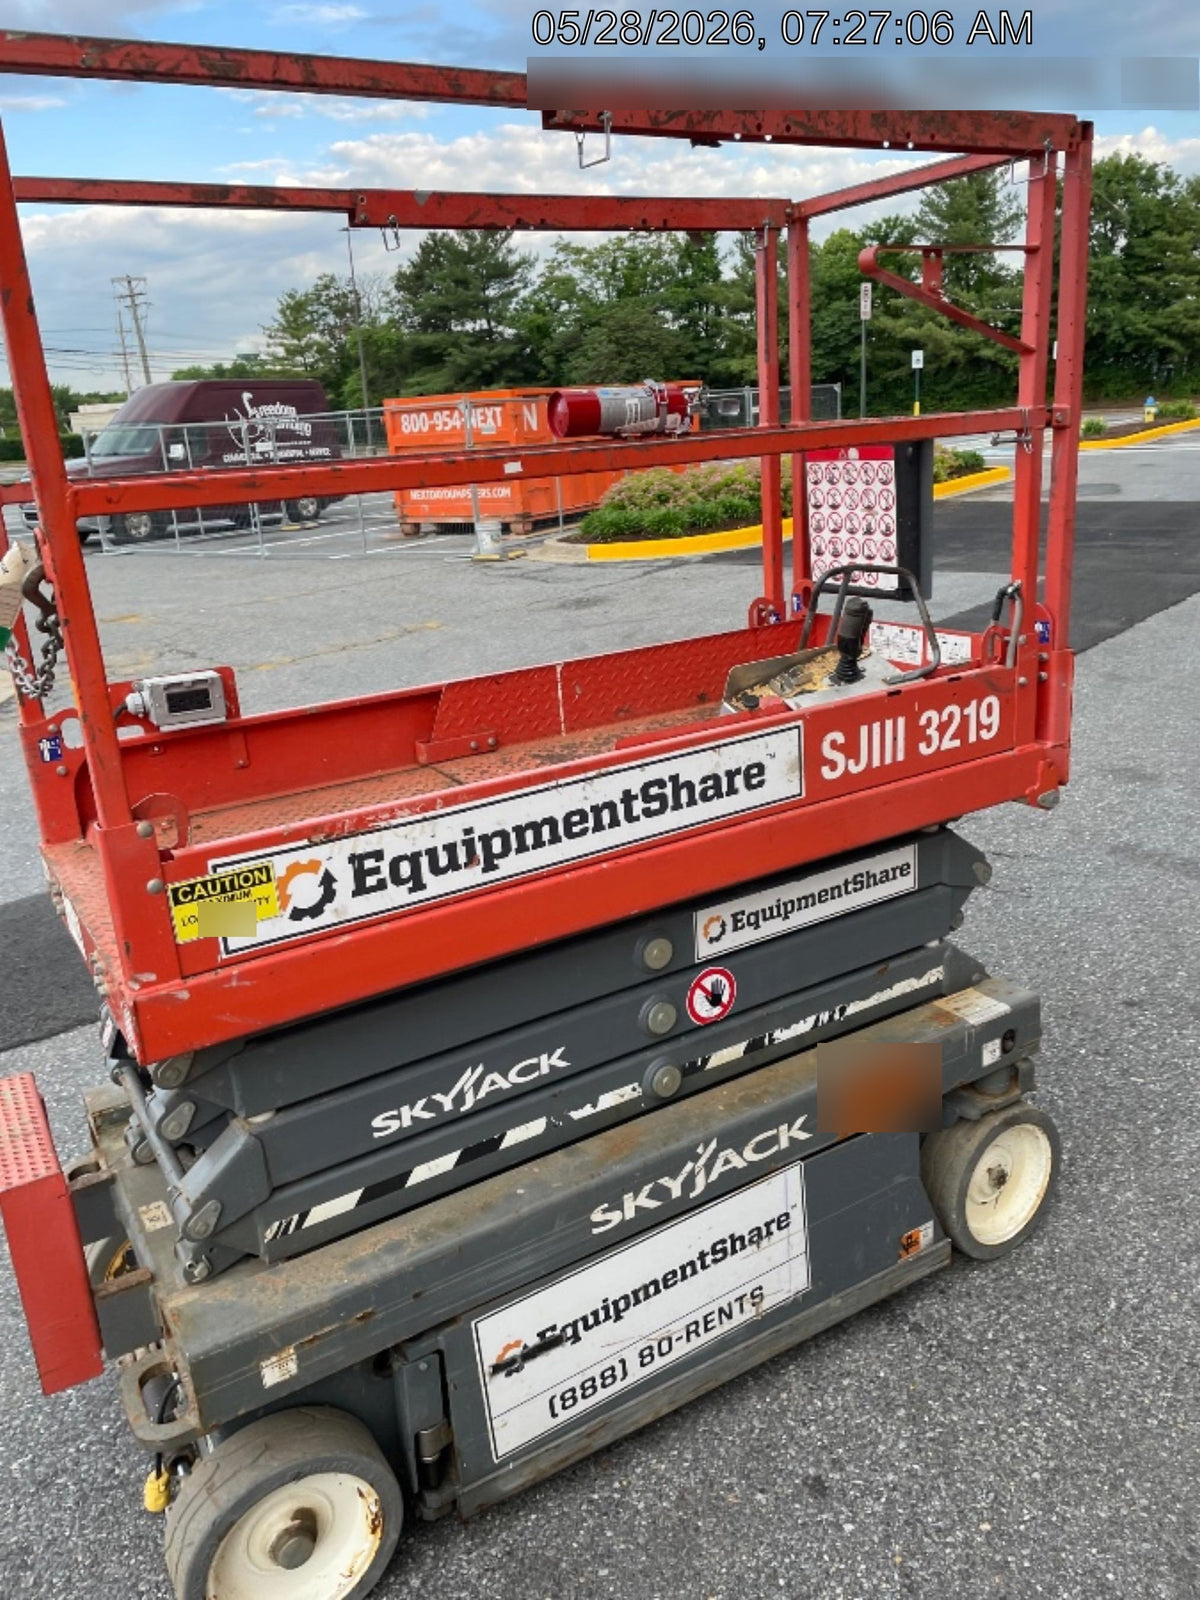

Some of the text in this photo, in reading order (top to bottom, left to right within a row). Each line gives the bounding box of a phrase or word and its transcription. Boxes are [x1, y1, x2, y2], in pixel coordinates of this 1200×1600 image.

[410, 487, 511, 500] NEXTDAYDUMPSERS.COM
[821, 694, 1000, 780] SJIII 3219
[348, 760, 767, 897] EquipmentShare
[178, 867, 268, 902] CAUTION
[730, 861, 911, 932] EquipmentShare
[371, 1046, 571, 1138] SKYJACK
[589, 1114, 813, 1235] SKYJACK
[549, 1284, 764, 1419] (888) 80-RENTS
